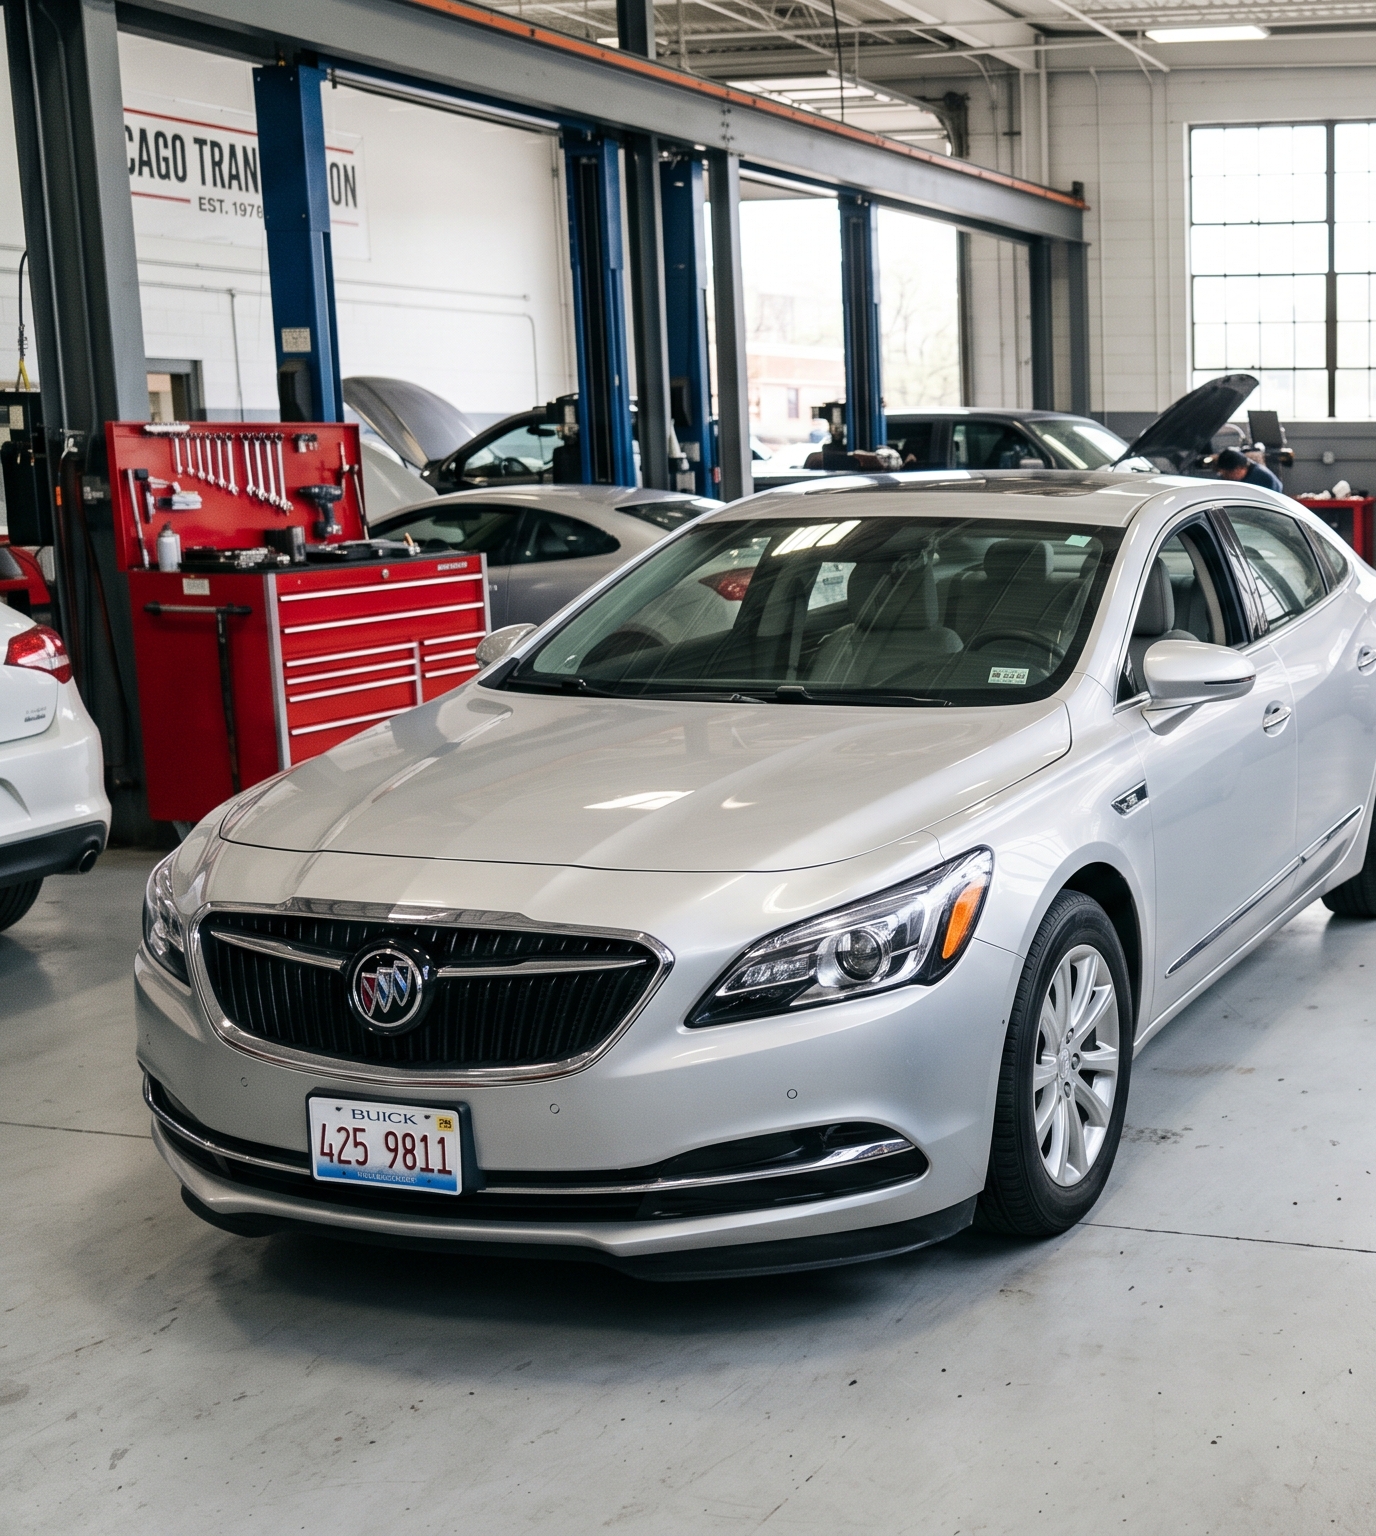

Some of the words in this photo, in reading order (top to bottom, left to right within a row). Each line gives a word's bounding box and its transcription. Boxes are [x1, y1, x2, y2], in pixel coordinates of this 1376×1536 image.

[198, 197, 229, 215] EST.
[351, 1108, 418, 1125] BUICK
[320, 1123, 369, 1166] 425
[384, 1130, 453, 1175] 9811
